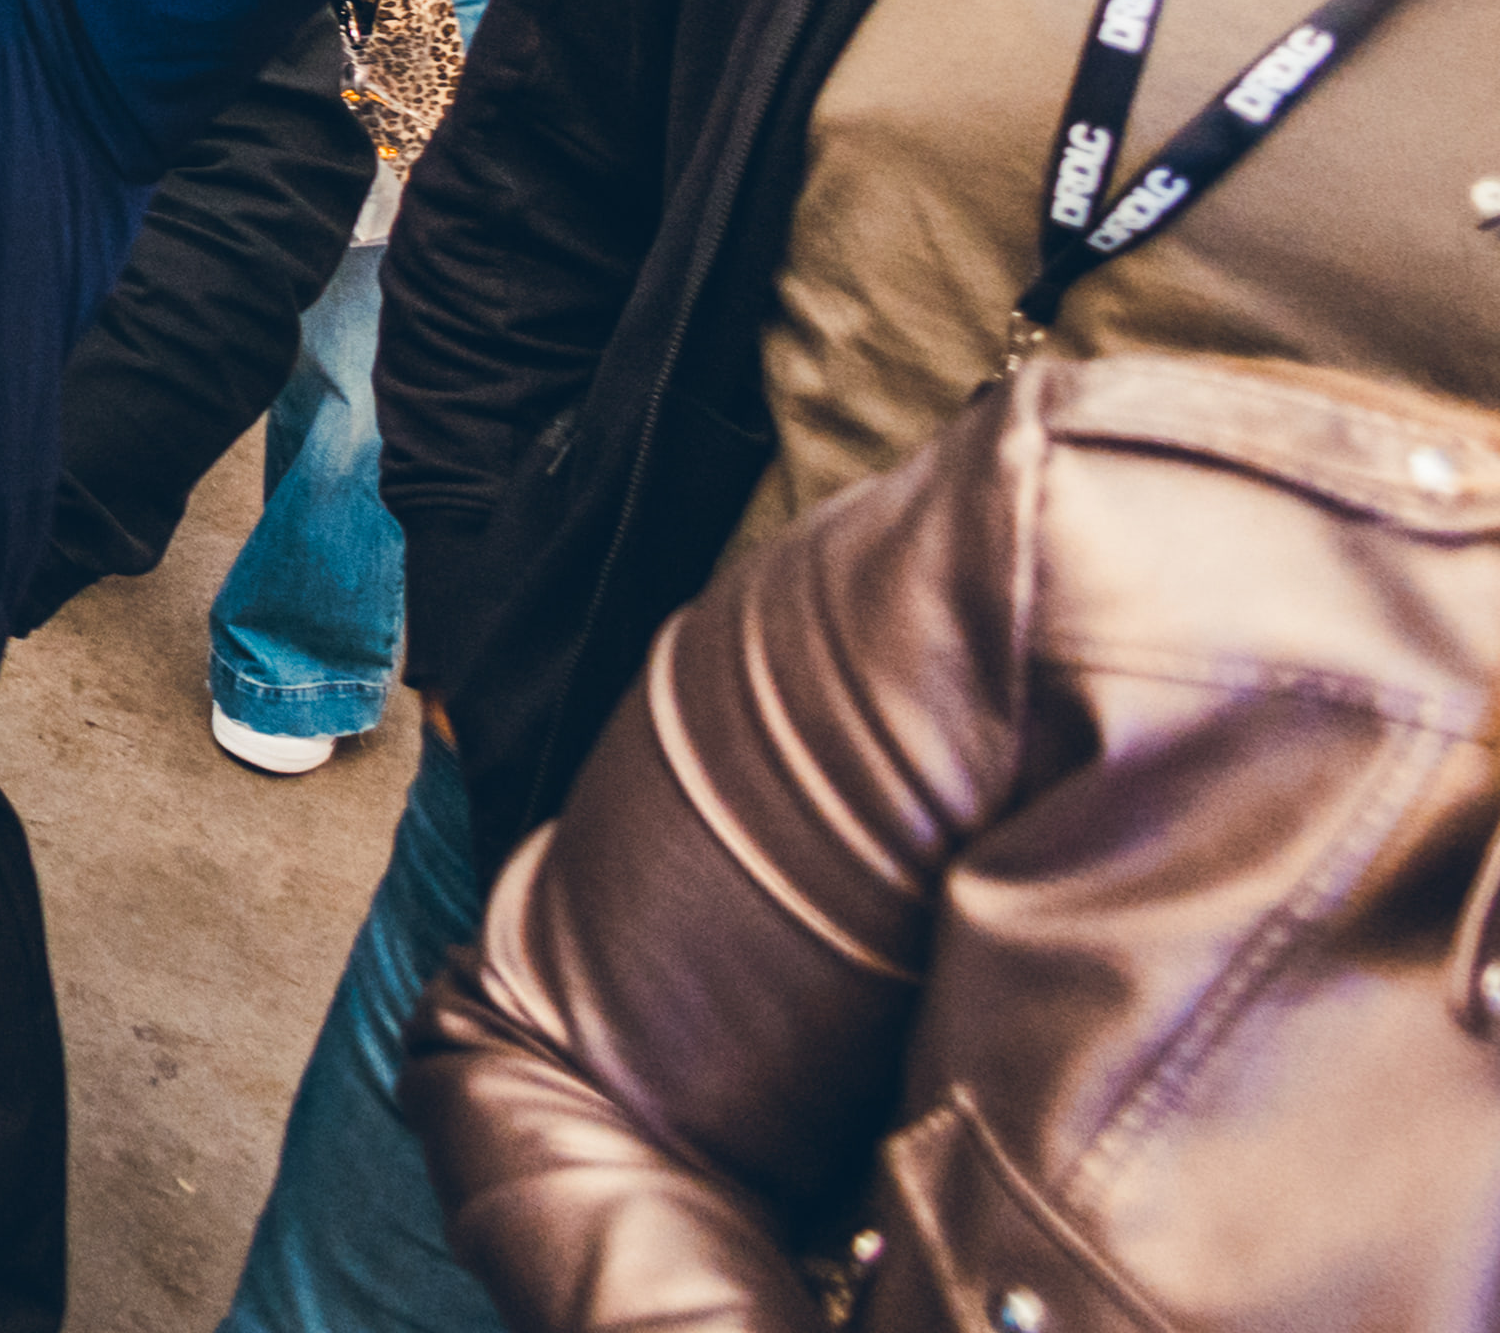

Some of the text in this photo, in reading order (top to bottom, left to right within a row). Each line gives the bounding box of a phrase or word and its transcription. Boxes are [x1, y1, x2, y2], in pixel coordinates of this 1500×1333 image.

[1226, 25, 1336, 125] DRDLC
[1051, 122, 1112, 229] DRDLC
[1087, 166, 1190, 253] DRDLC
